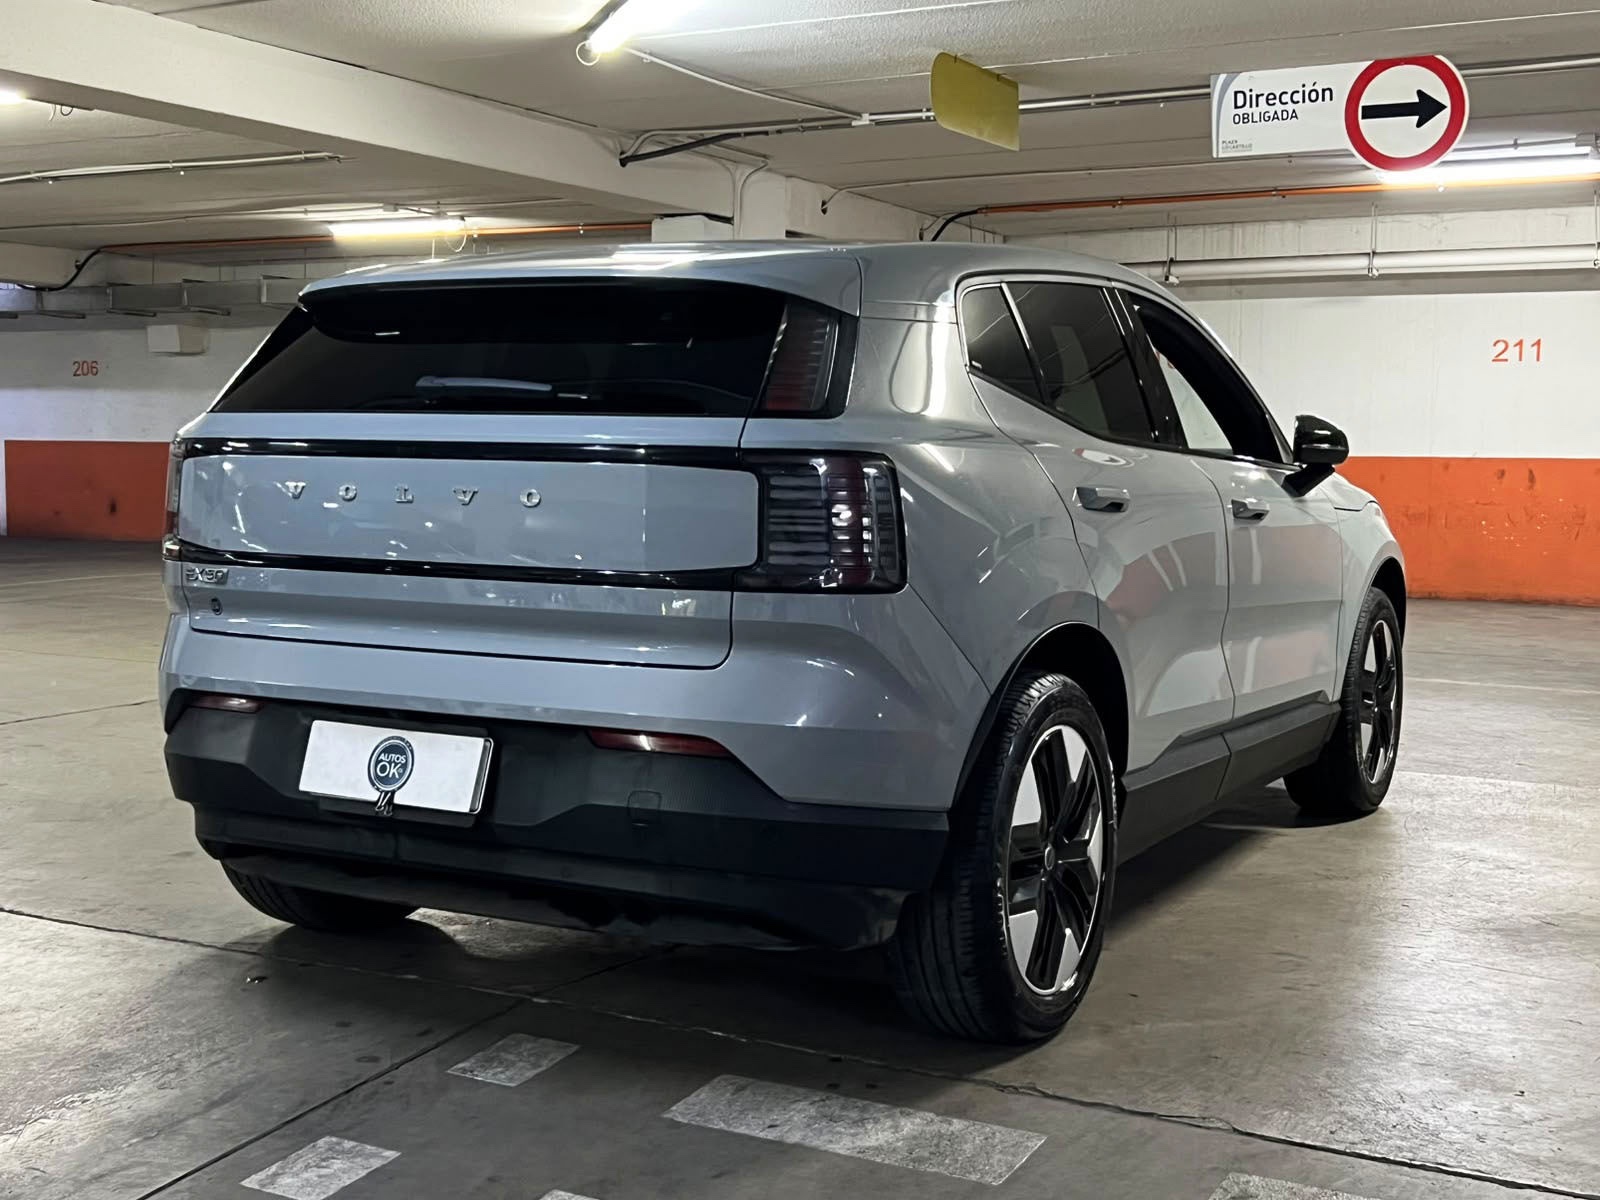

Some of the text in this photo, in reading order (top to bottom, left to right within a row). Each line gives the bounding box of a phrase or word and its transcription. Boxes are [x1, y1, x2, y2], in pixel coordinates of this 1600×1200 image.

[1233, 82, 1333, 108] Dirección
[1233, 109, 1298, 124] OBLIGADA
[1491, 338, 1542, 362] 211
[72, 361, 99, 376] 206
[285, 481, 542, 508] VOLVO
[378, 753, 406, 763] AUTOS
[377, 761, 402, 778] OK
